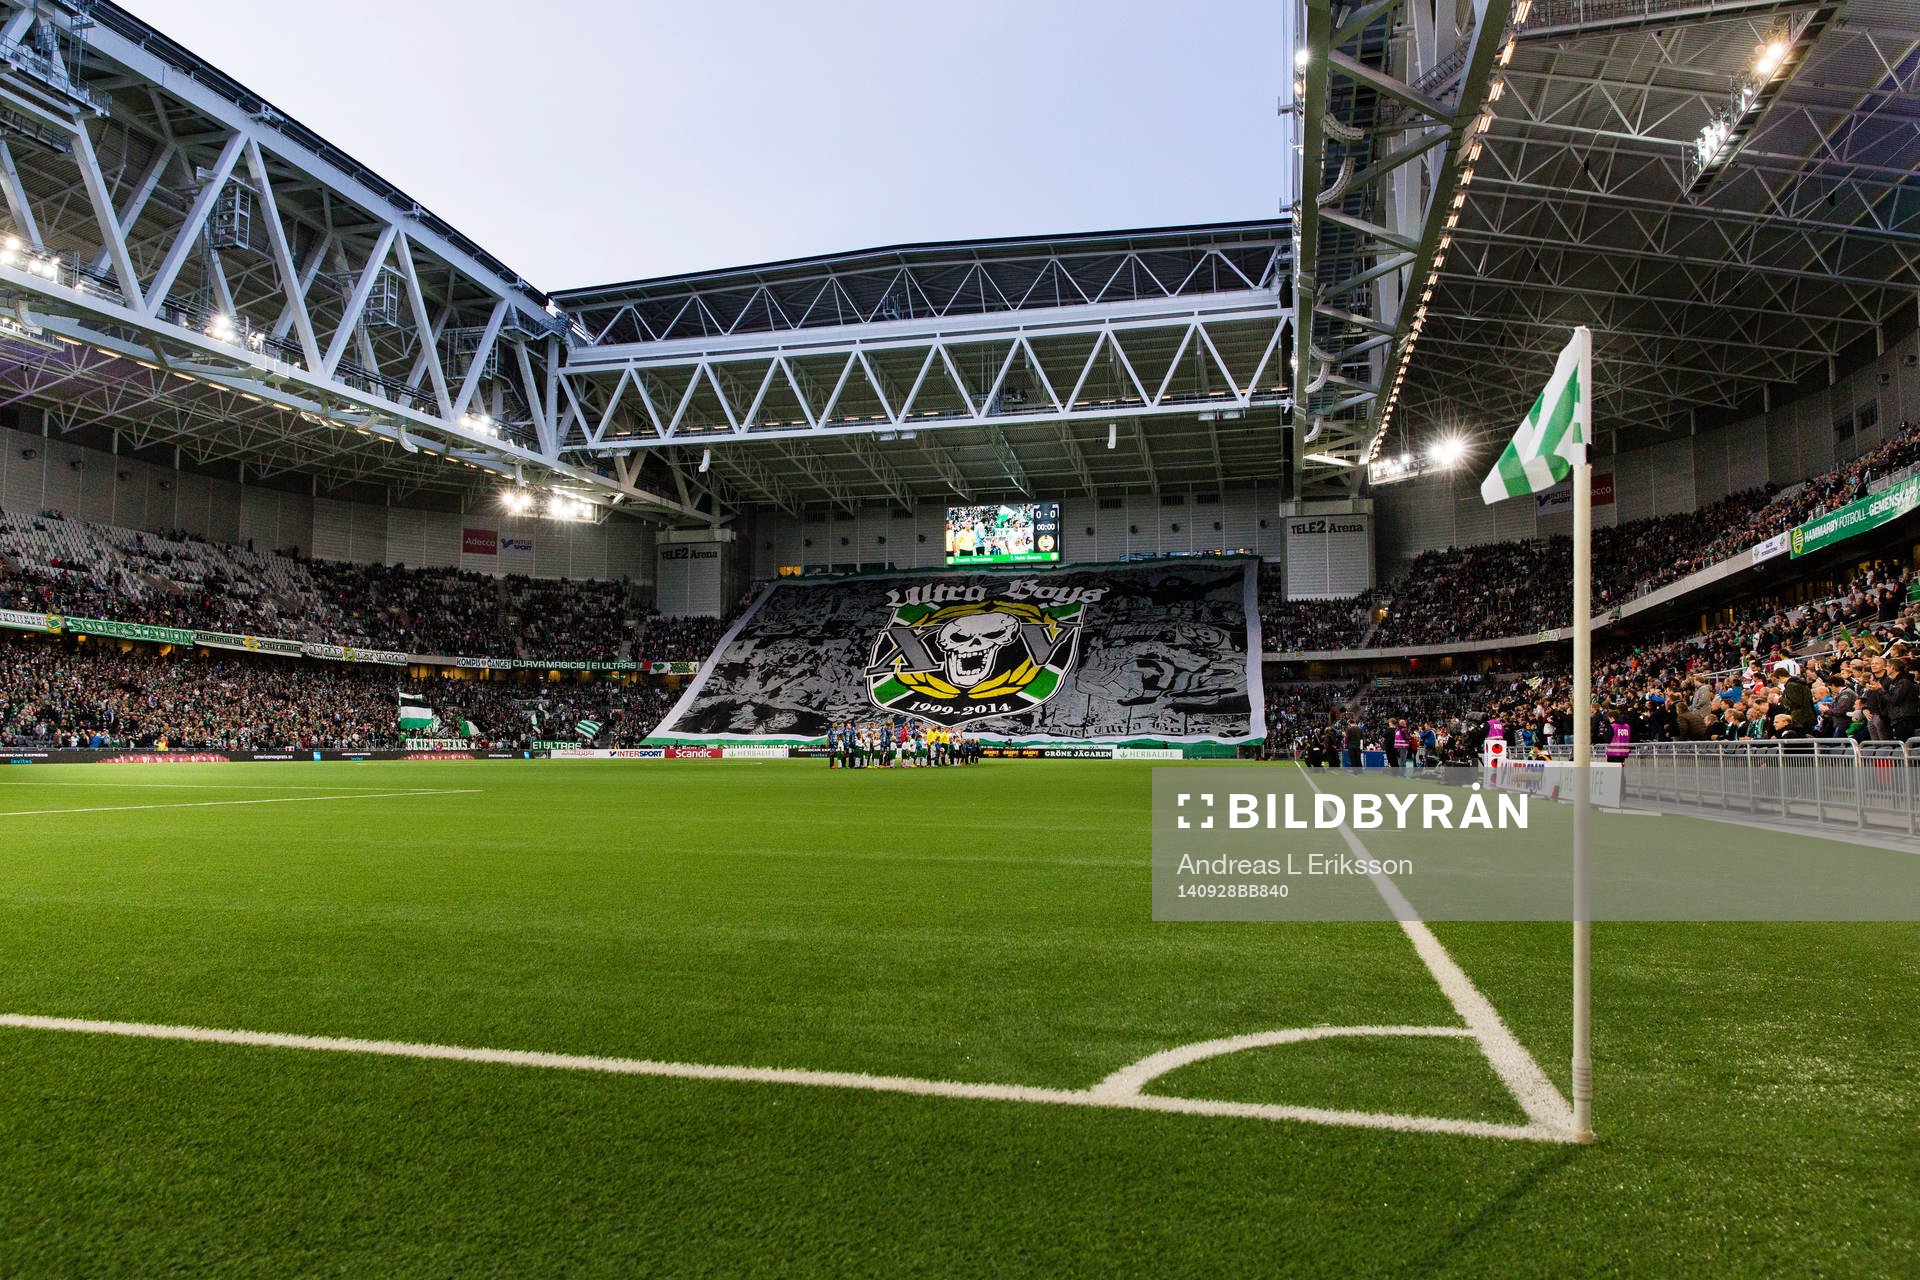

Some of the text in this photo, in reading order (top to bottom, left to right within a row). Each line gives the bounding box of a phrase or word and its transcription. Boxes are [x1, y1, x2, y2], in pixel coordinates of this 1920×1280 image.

[1591, 486, 1612, 497] ecco
[1036, 510, 1042, 519] 0
[1050, 509, 1056, 518] 0
[1291, 520, 1364, 534] TELE2 Arena
[1804, 519, 1840, 543] HAMMARBY
[1840, 508, 1867, 528] FOTBOLL
[465, 537, 496, 547] Adecco
[662, 547, 718, 560] TELE2 Arena
[886, 579, 1111, 607] Ultra Boys
[513, 659, 545, 668] CURVA
[546, 660, 586, 669] MAGICIS
[602, 661, 637, 670] ULTRAS
[906, 700, 1012, 716] 1999-2014
[617, 750, 662, 758] INTERSPORT
[675, 748, 712, 758] Scandic
[1044, 749, 1112, 757] GRÖNE JÄGAREN
[1130, 750, 1174, 758] HERBALIFE
